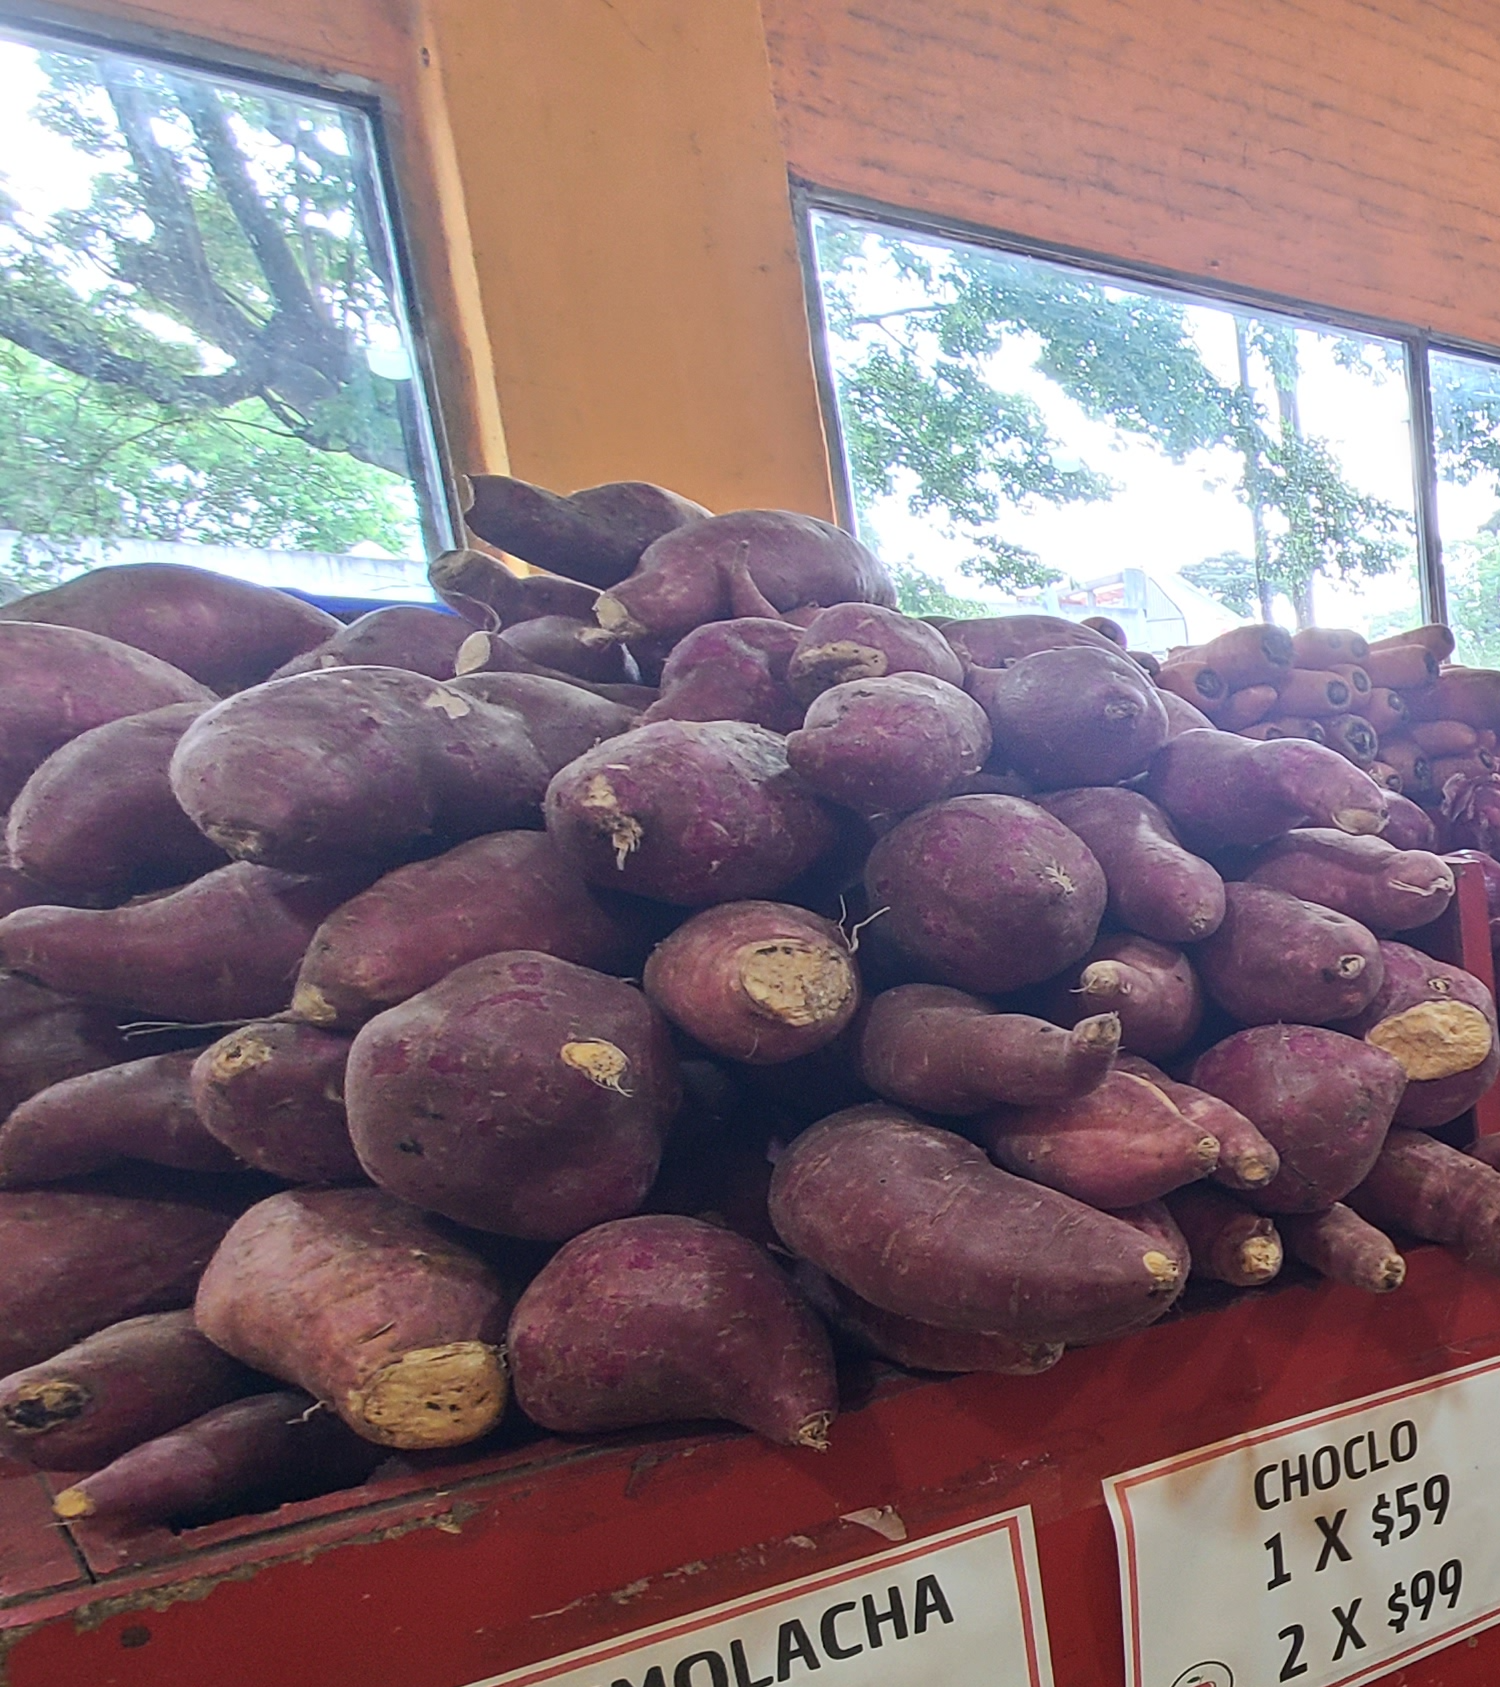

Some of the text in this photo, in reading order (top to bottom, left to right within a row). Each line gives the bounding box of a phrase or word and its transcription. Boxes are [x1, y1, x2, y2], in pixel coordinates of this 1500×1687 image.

[1253, 1419, 1418, 1511] CHOCLO
[1263, 1473, 1451, 1591] 1 X $59
[610, 1573, 955, 1687] OLACHA
[1277, 1558, 1463, 1683] 2 X $99
